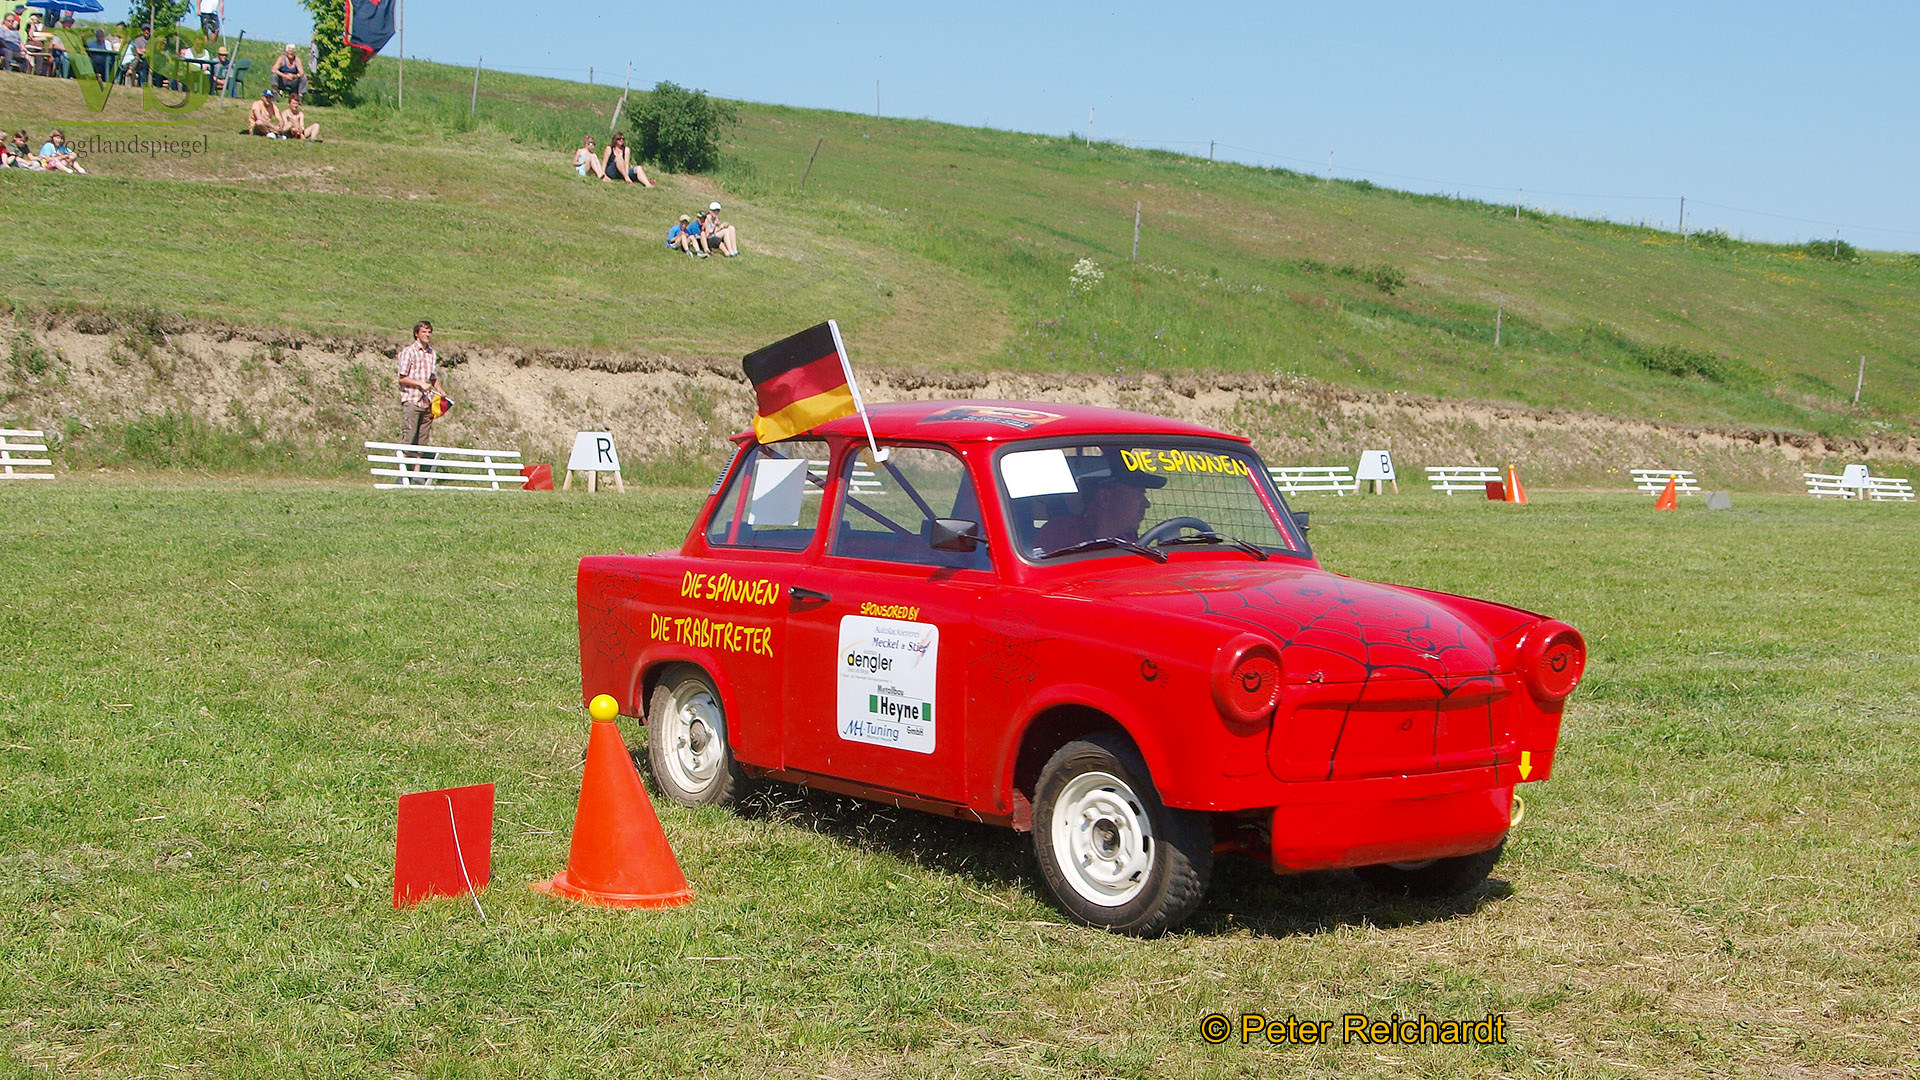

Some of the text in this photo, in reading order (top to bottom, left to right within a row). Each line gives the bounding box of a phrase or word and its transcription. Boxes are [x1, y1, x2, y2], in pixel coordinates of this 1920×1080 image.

[596, 437, 613, 463] R
[1119, 449, 1249, 476] DIE SPINNEN
[1380, 454, 1390, 474] B
[681, 570, 780, 606] DIE SPINNEN
[860, 601, 920, 621] SPONSORED BY
[650, 613, 774, 658] DIE TRABITRETER
[872, 637, 899, 650] Meckel
[847, 650, 893, 673] dengler
[880, 696, 919, 722] Heyne
[907, 725, 924, 736] GmbH
